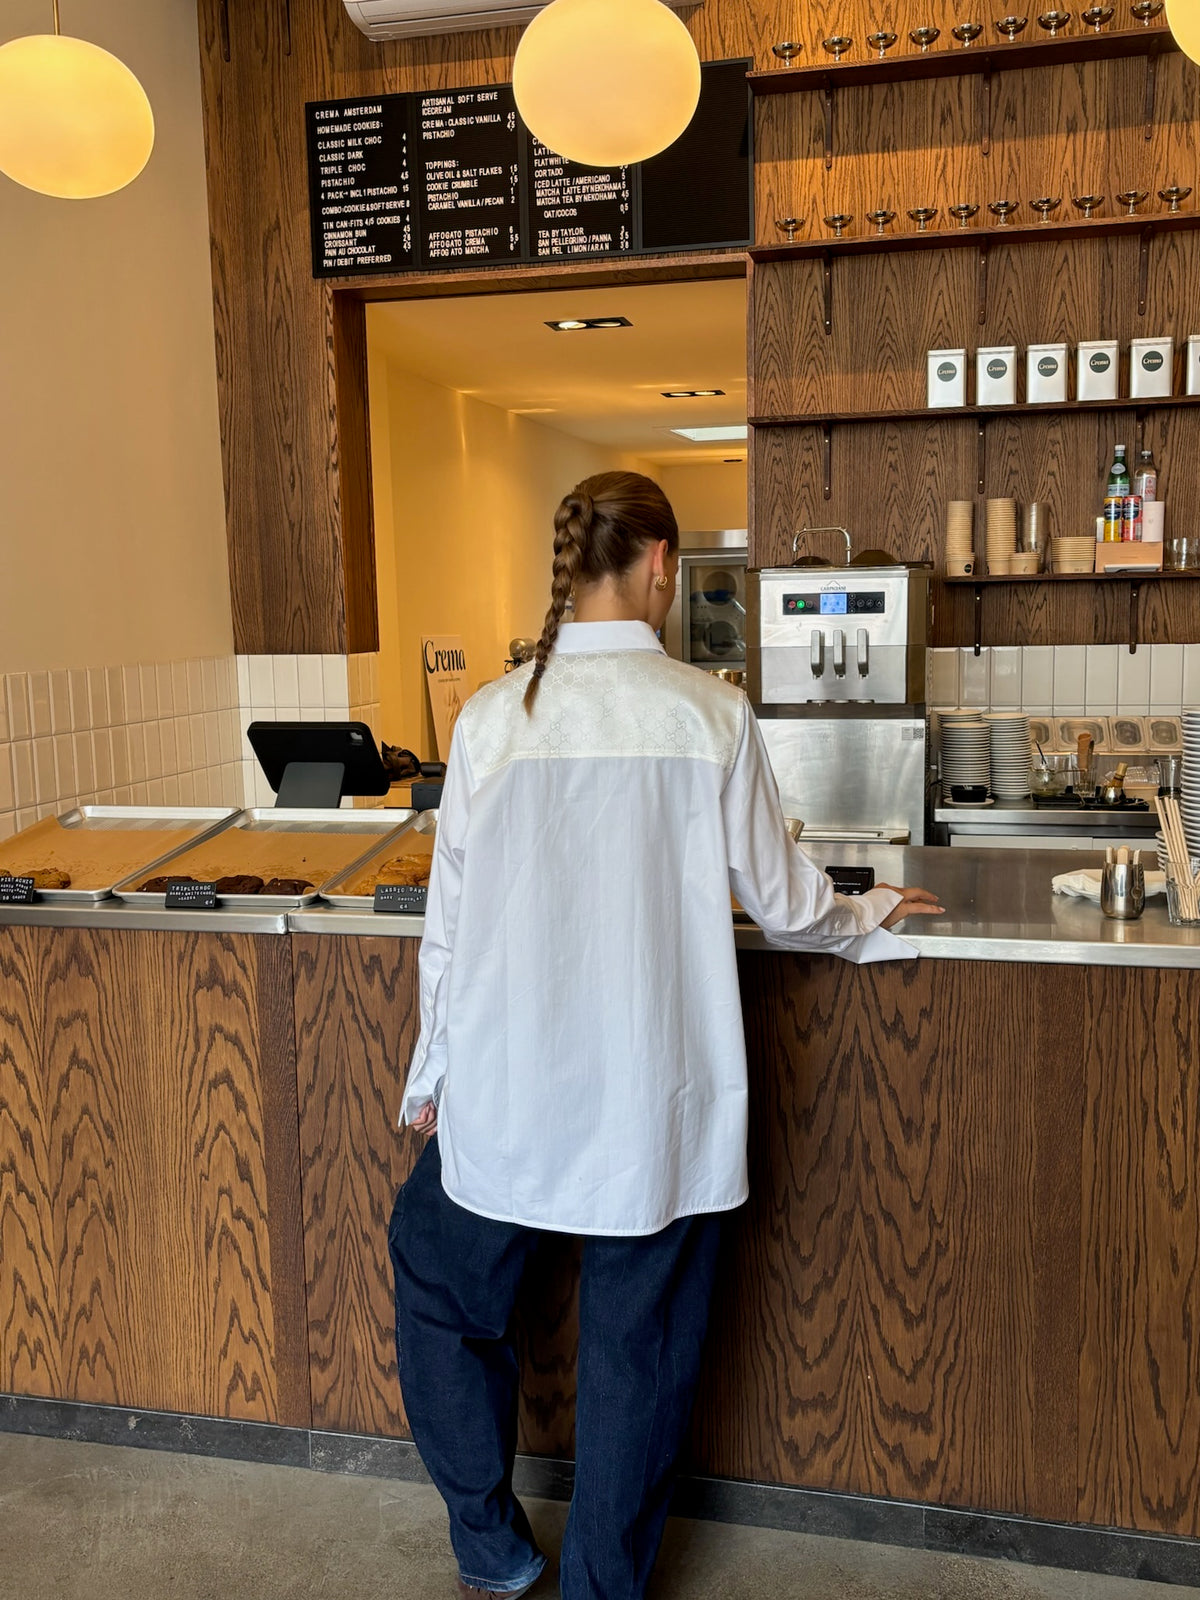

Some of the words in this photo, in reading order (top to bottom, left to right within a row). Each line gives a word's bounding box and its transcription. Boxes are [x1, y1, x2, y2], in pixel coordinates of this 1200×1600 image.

[422, 96, 454, 107] ARTISANAL
[458, 94, 474, 103] SOFT
[477, 92, 498, 102] SERVE
[315, 110, 339, 119] CREMA
[344, 105, 382, 116] AMSTERDAM
[422, 106, 452, 116] ICECREAM
[475, 114, 501, 124] VANILLA
[317, 123, 351, 134] HOMEMADE
[423, 130, 455, 140] PISTACHIO
[318, 140, 345, 149] CLASSIC
[347, 138, 362, 147] MILK
[364, 136, 382, 145] CHOC
[402, 133, 406, 141] 4
[319, 152, 345, 162] CLASSIC
[347, 150, 363, 160] DARK
[402, 146, 406, 154] 4
[320, 166, 343, 175] TRIPLE
[348, 163, 366, 172] CHOC
[402, 159, 406, 167] 4
[425, 160, 459, 170] TOPPINGS:
[426, 172, 444, 180] OLIVE
[462, 169, 477, 177] SALT
[479, 167, 502, 176] FLAKES
[535, 168, 563, 178] CORTADO
[321, 177, 355, 187] PISTACHIO
[426, 182, 448, 191] COOKIE
[452, 180, 478, 189] CRUMBLE
[534, 180, 550, 189] ICED
[551, 178, 570, 187] LATTE
[367, 186, 398, 196] PISTACHIO
[536, 188, 560, 197] MATCHA
[563, 186, 581, 195] LATTE
[582, 186, 589, 194] BY
[590, 182, 621, 192] NEKOHAMA
[427, 192, 459, 202] PISTACHIO
[536, 197, 560, 206] MATCHA
[583, 192, 617, 202] NEKOHAMA
[428, 201, 455, 210] CARAMEL
[323, 222, 334, 230] TIN
[376, 216, 400, 225] COOKIES
[324, 231, 353, 240] CINNAMON
[429, 231, 462, 240] AFFOGATO
[465, 228, 498, 237] PISTACHIO
[538, 230, 550, 238] TEA
[552, 229, 559, 237] BY
[561, 227, 584, 236] TAYLOR
[324, 238, 357, 248] CROISSANT
[429, 239, 462, 249] AFFOGATO
[465, 237, 485, 246] CREMA
[538, 239, 550, 247] SAN
[551, 236, 587, 246] PELLEGRINO
[325, 248, 337, 256] PAIN
[347, 245, 376, 255] CHOCOLAT
[465, 246, 489, 254] MATCHA
[538, 248, 550, 256] SAN
[552, 246, 563, 254] PEL
[357, 255, 392, 264] PREFERRED
[424, 640, 466, 674] Crema
